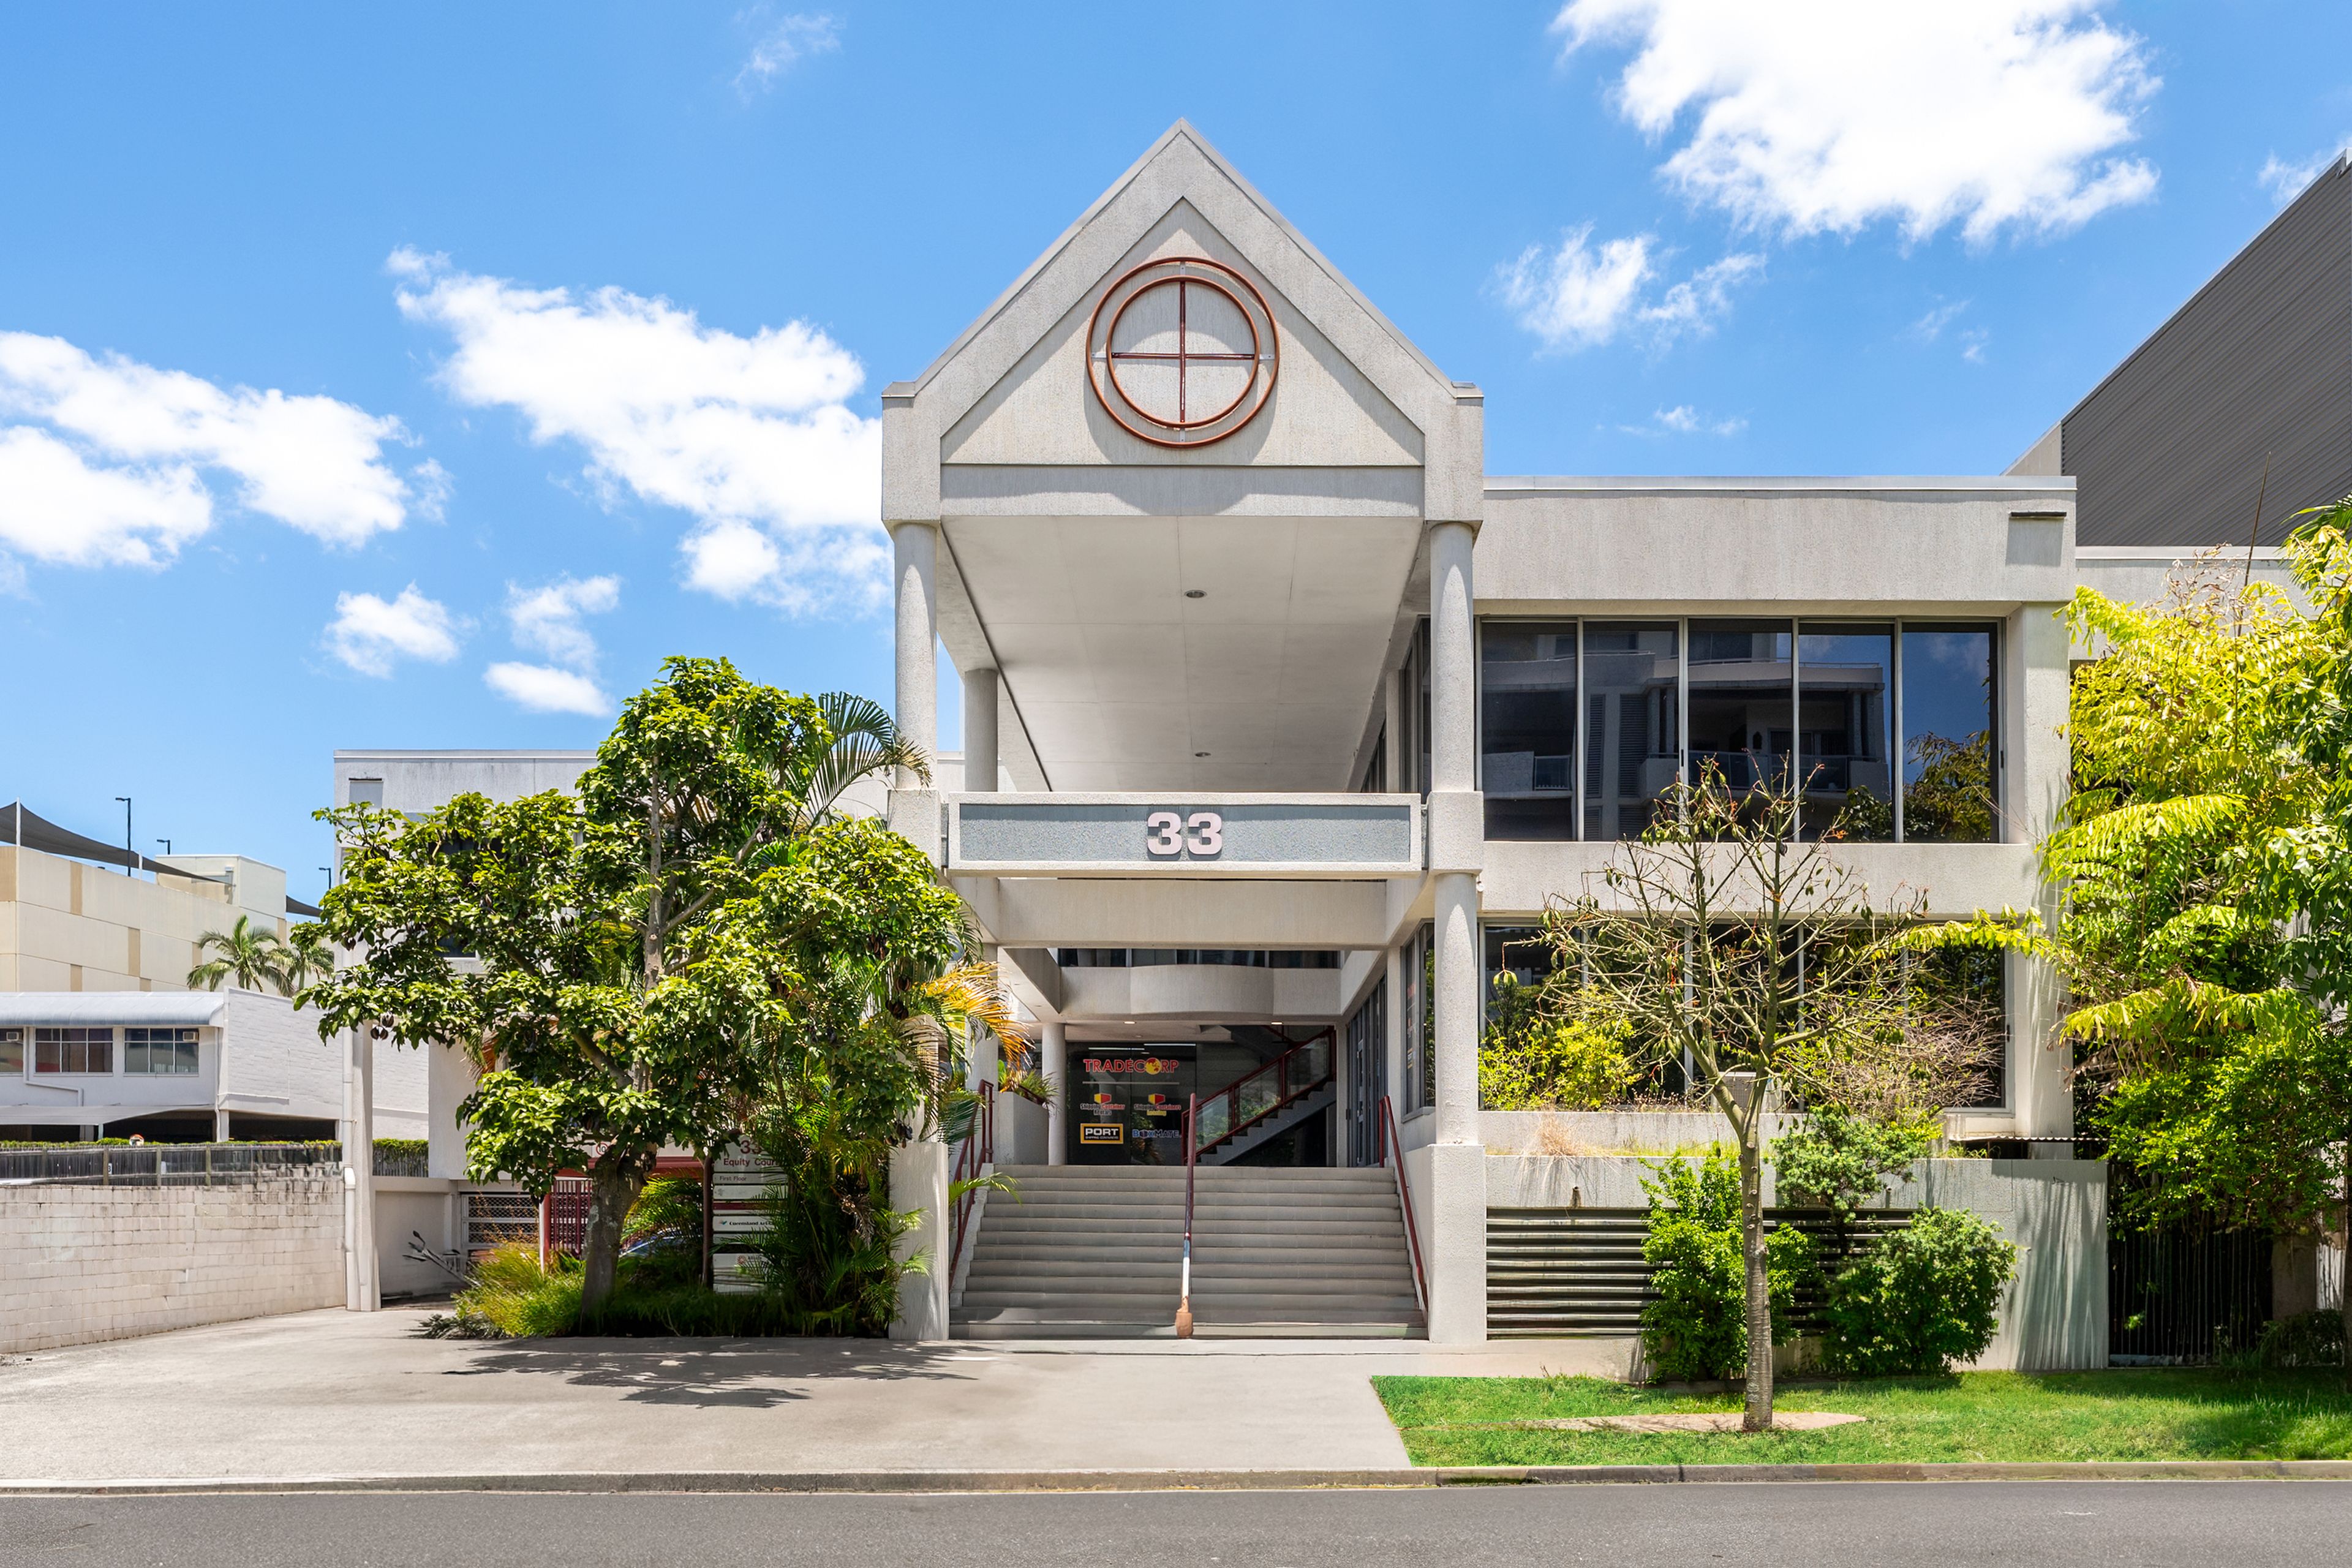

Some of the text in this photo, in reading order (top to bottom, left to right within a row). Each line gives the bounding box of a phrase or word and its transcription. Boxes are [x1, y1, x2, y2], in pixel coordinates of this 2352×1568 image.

[1147, 812, 1222, 854] 33
[1083, 1058, 1180, 1075] TRADECORP
[740, 1140, 762, 1154] 33
[723, 1158, 750, 1167] Equity
